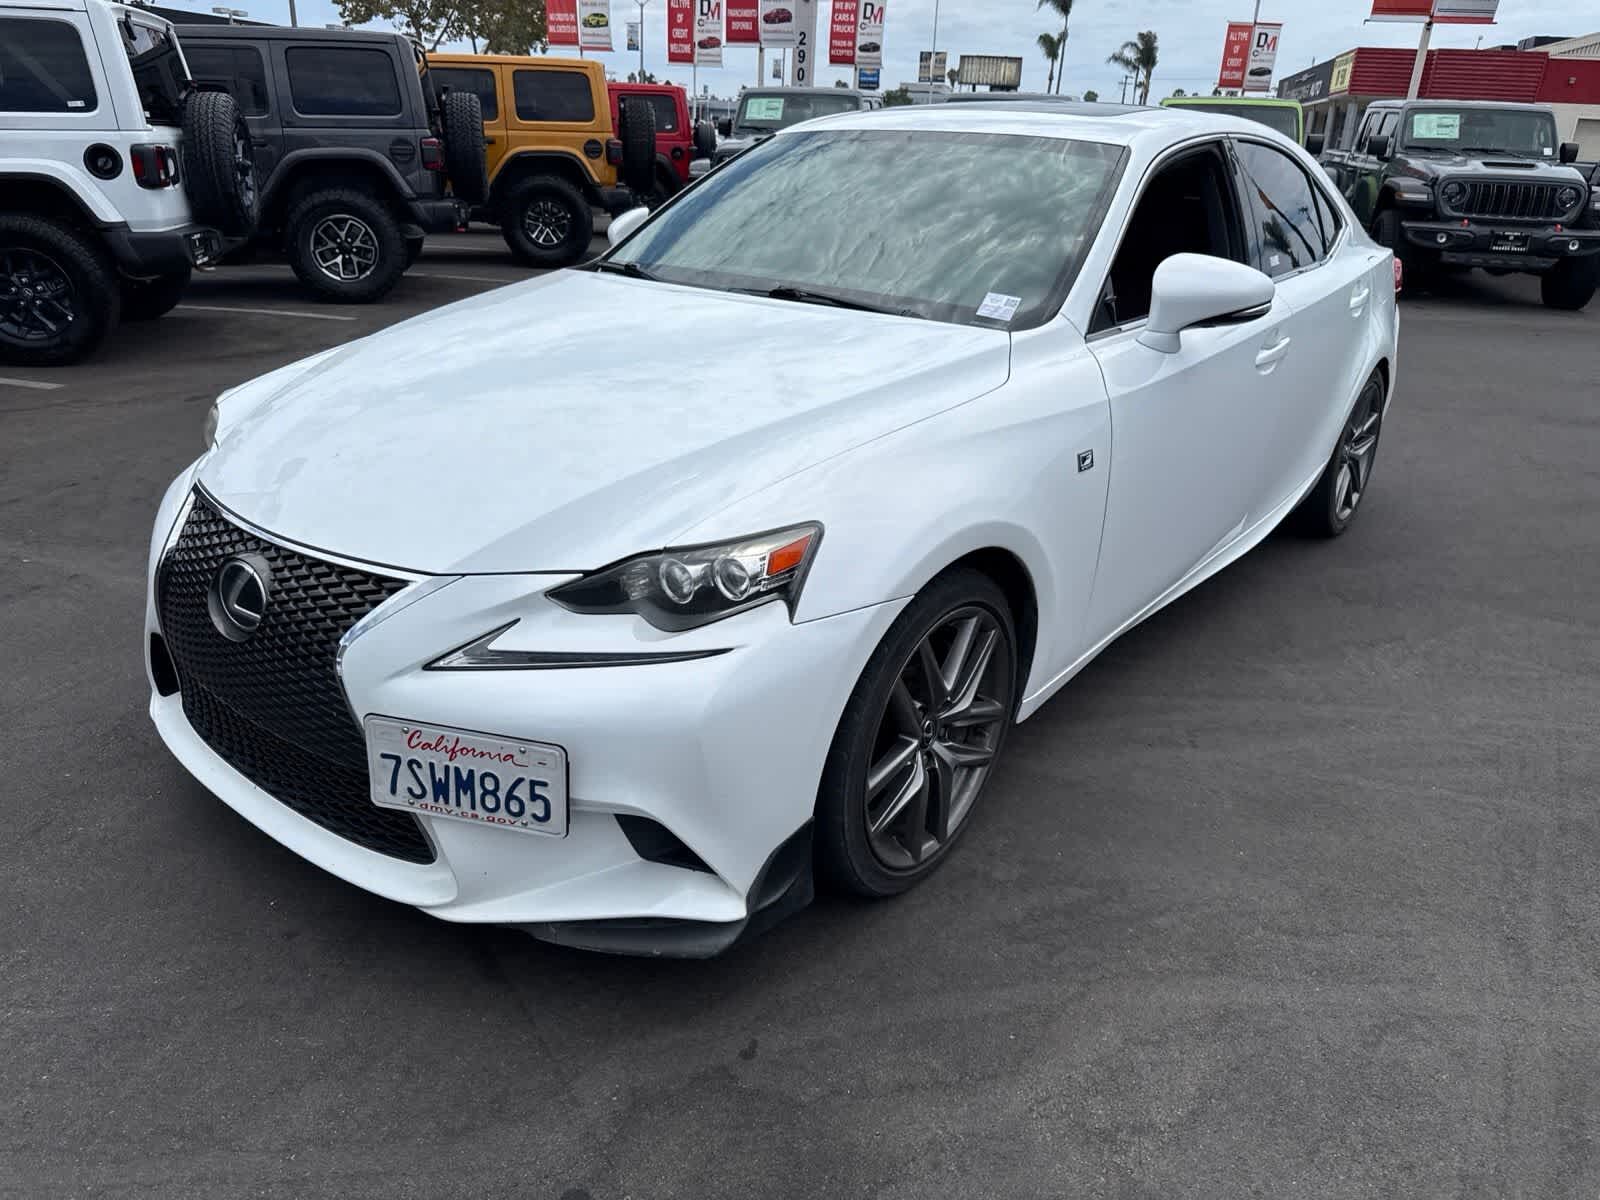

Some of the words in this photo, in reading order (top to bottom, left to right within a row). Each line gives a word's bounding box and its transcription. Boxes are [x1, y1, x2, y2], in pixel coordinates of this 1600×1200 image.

[834, 13, 849, 21] CARS
[843, 3, 856, 11] BUY
[864, 3, 883, 24] DM
[832, 24, 855, 33] TRUCKS
[1256, 32, 1278, 51] DM
[797, 31, 806, 87] 290
[407, 729, 529, 767] California
[380, 752, 552, 823] 7SWM865
[419, 802, 517, 825] dmv.ca.gov
